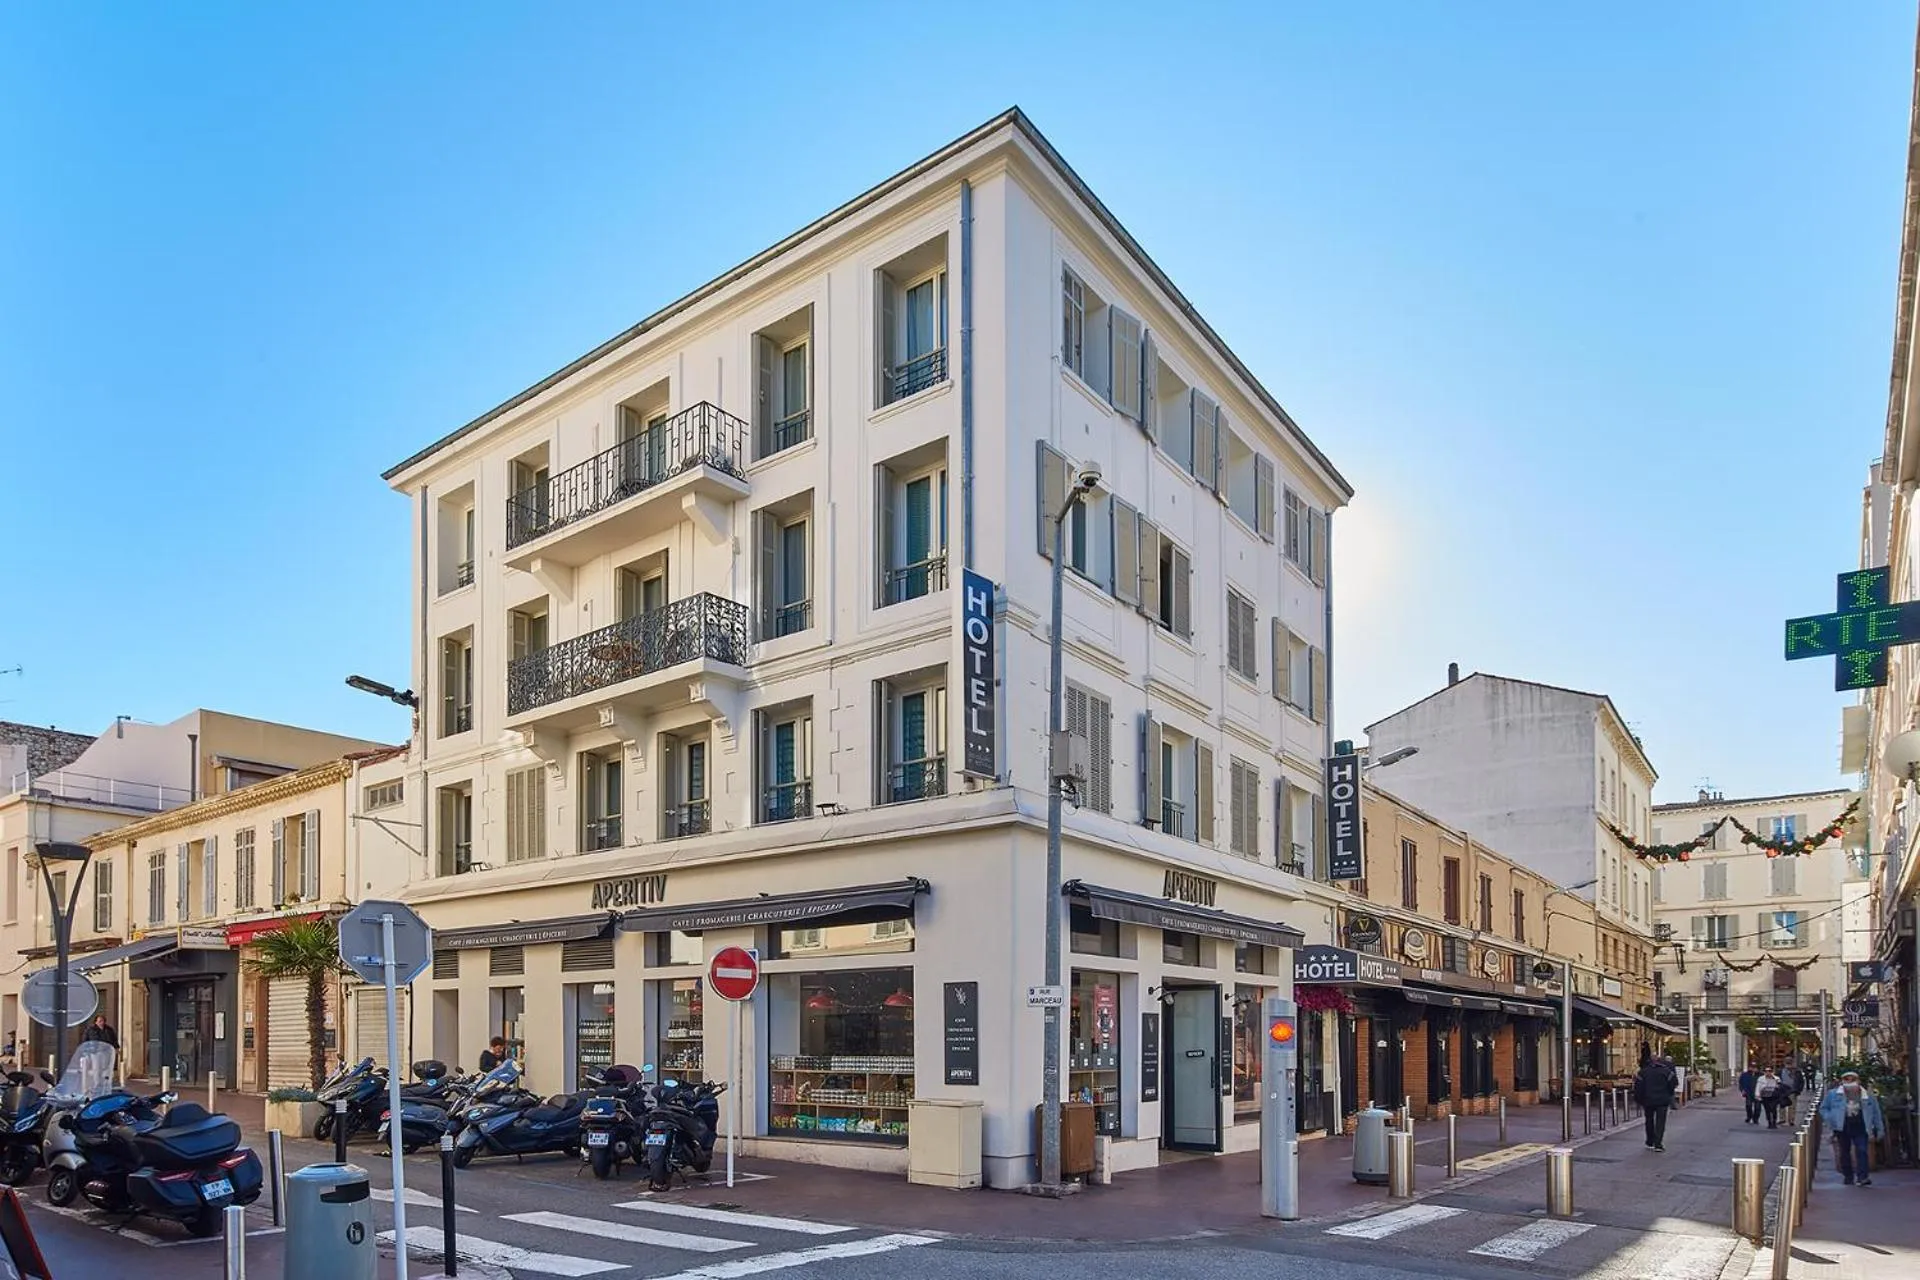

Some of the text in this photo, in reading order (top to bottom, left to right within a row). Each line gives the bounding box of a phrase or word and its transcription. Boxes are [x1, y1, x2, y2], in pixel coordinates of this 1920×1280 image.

[966, 586, 989, 736] HOTEL
[1331, 764, 1354, 856] HOTEL
[591, 874, 668, 909] APERITIV
[1163, 870, 1217, 907] APERITIV
[1295, 962, 1355, 979] HOTEL
[1360, 960, 1384, 980] HOTEL
